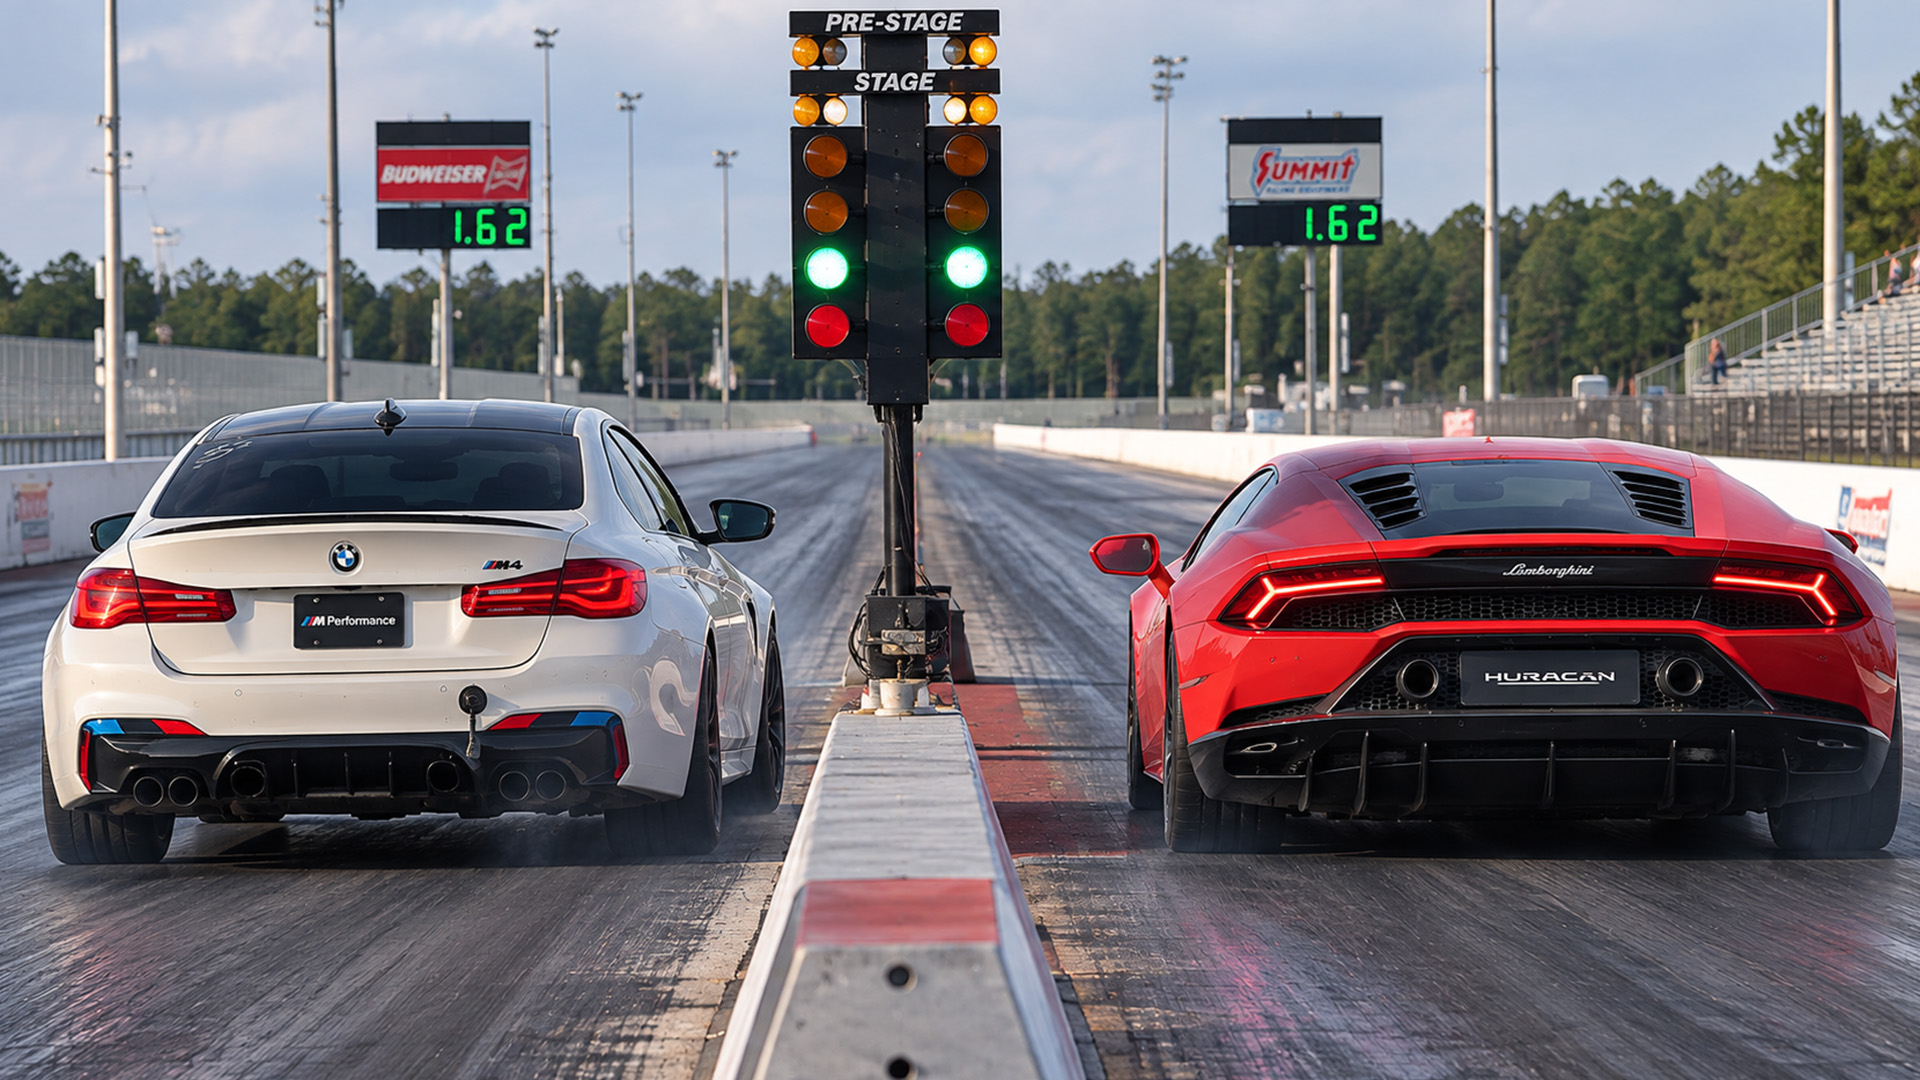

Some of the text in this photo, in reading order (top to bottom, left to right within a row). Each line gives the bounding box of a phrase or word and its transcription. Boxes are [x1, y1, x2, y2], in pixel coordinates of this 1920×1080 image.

[825, 12, 964, 32] PRE-STAGE
[854, 72, 936, 92] STAGE
[380, 164, 487, 184] BUDWEISER
[454, 208, 527, 246] 1.62
[1306, 204, 1378, 242] 1.62
[495, 560, 523, 570] M4
[1503, 563, 1594, 578] Lamborghini
[327, 615, 396, 627] Performance
